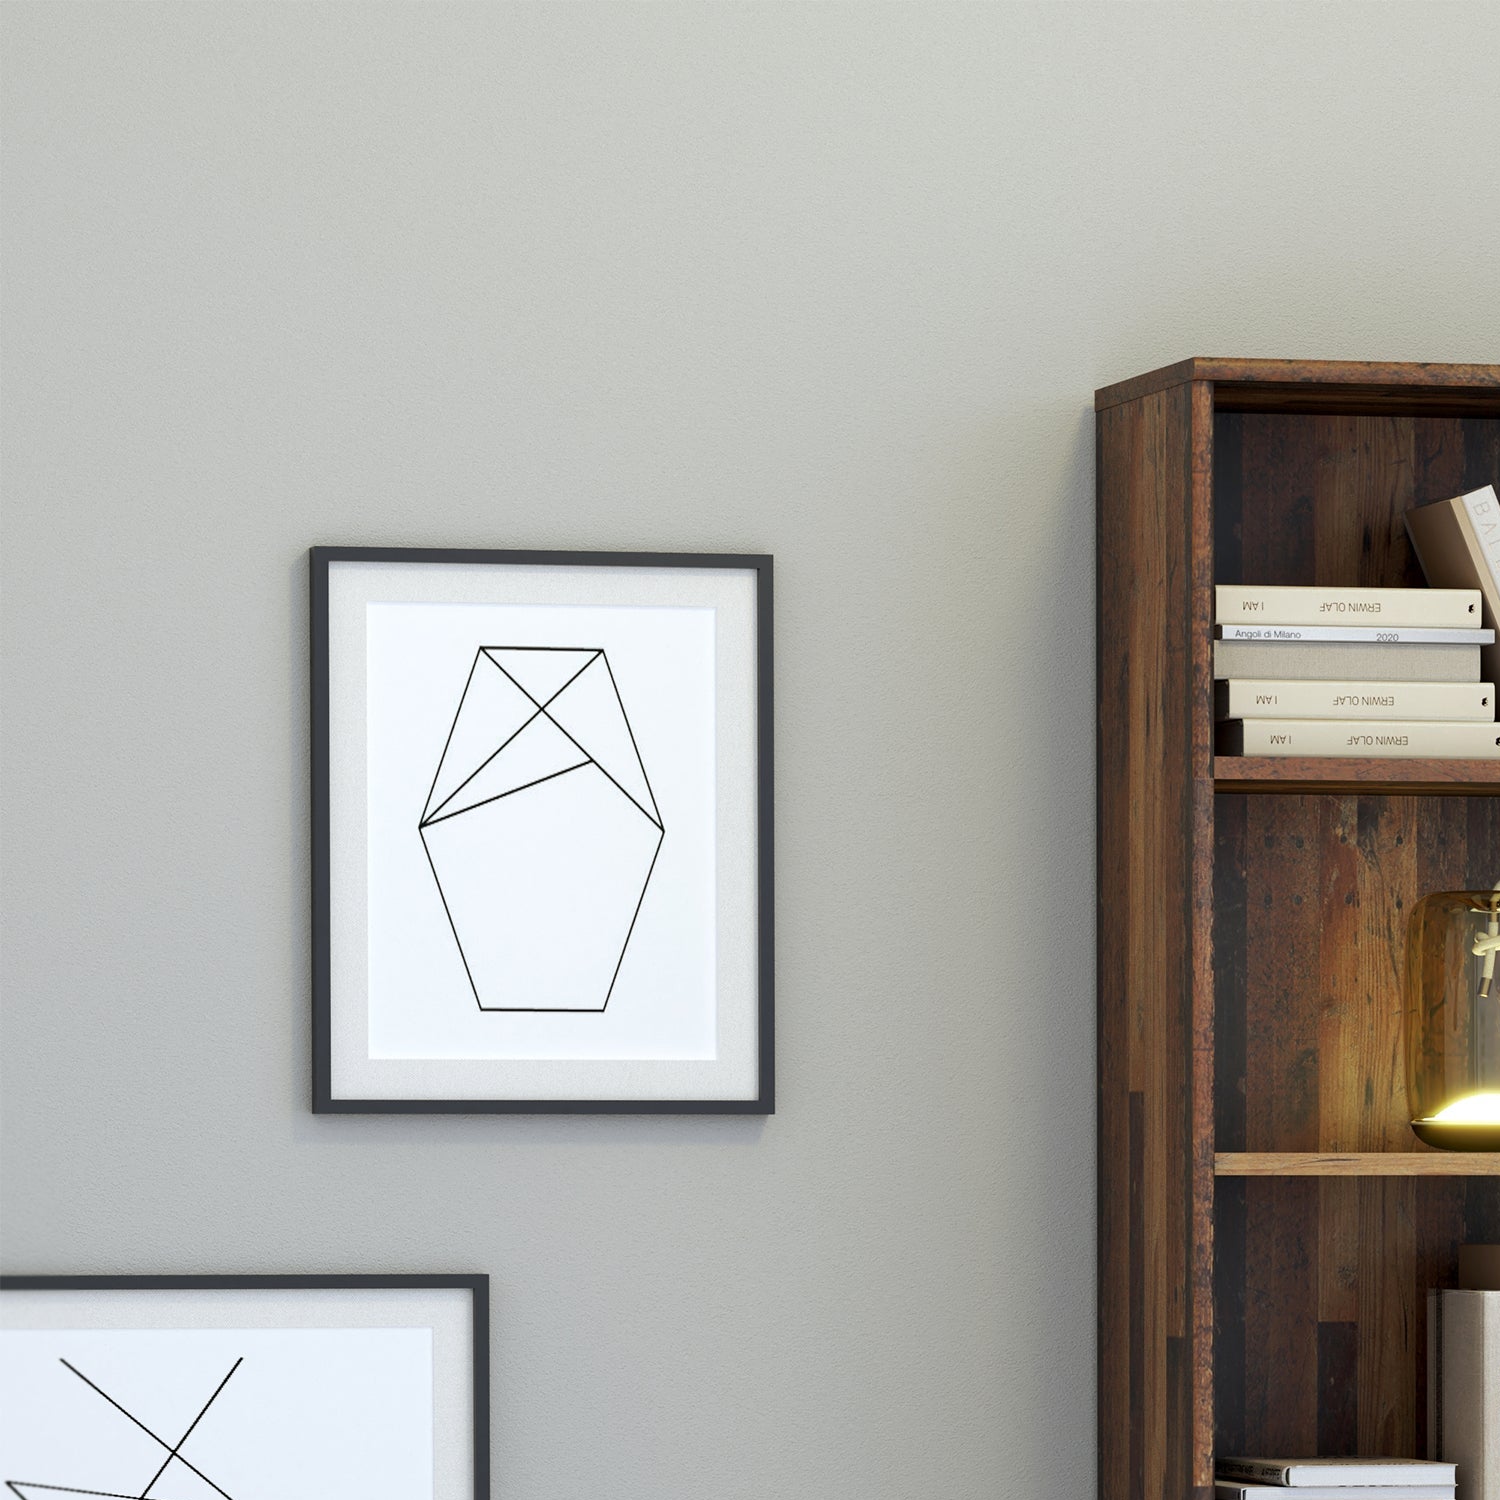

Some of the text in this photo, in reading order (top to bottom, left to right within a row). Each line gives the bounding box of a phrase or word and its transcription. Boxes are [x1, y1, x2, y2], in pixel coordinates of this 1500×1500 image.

[1242, 601, 1259, 611] AM
[1319, 602, 1381, 613] ERWIN OLAF
[1235, 629, 1301, 639] Angoli di Milano
[1376, 633, 1399, 642] 2020
[1256, 695, 1272, 704] AM
[1333, 696, 1395, 706] ERWIN OLAF
[1270, 735, 1286, 744] AM
[1347, 735, 1409, 745] ERWIN OLAF
